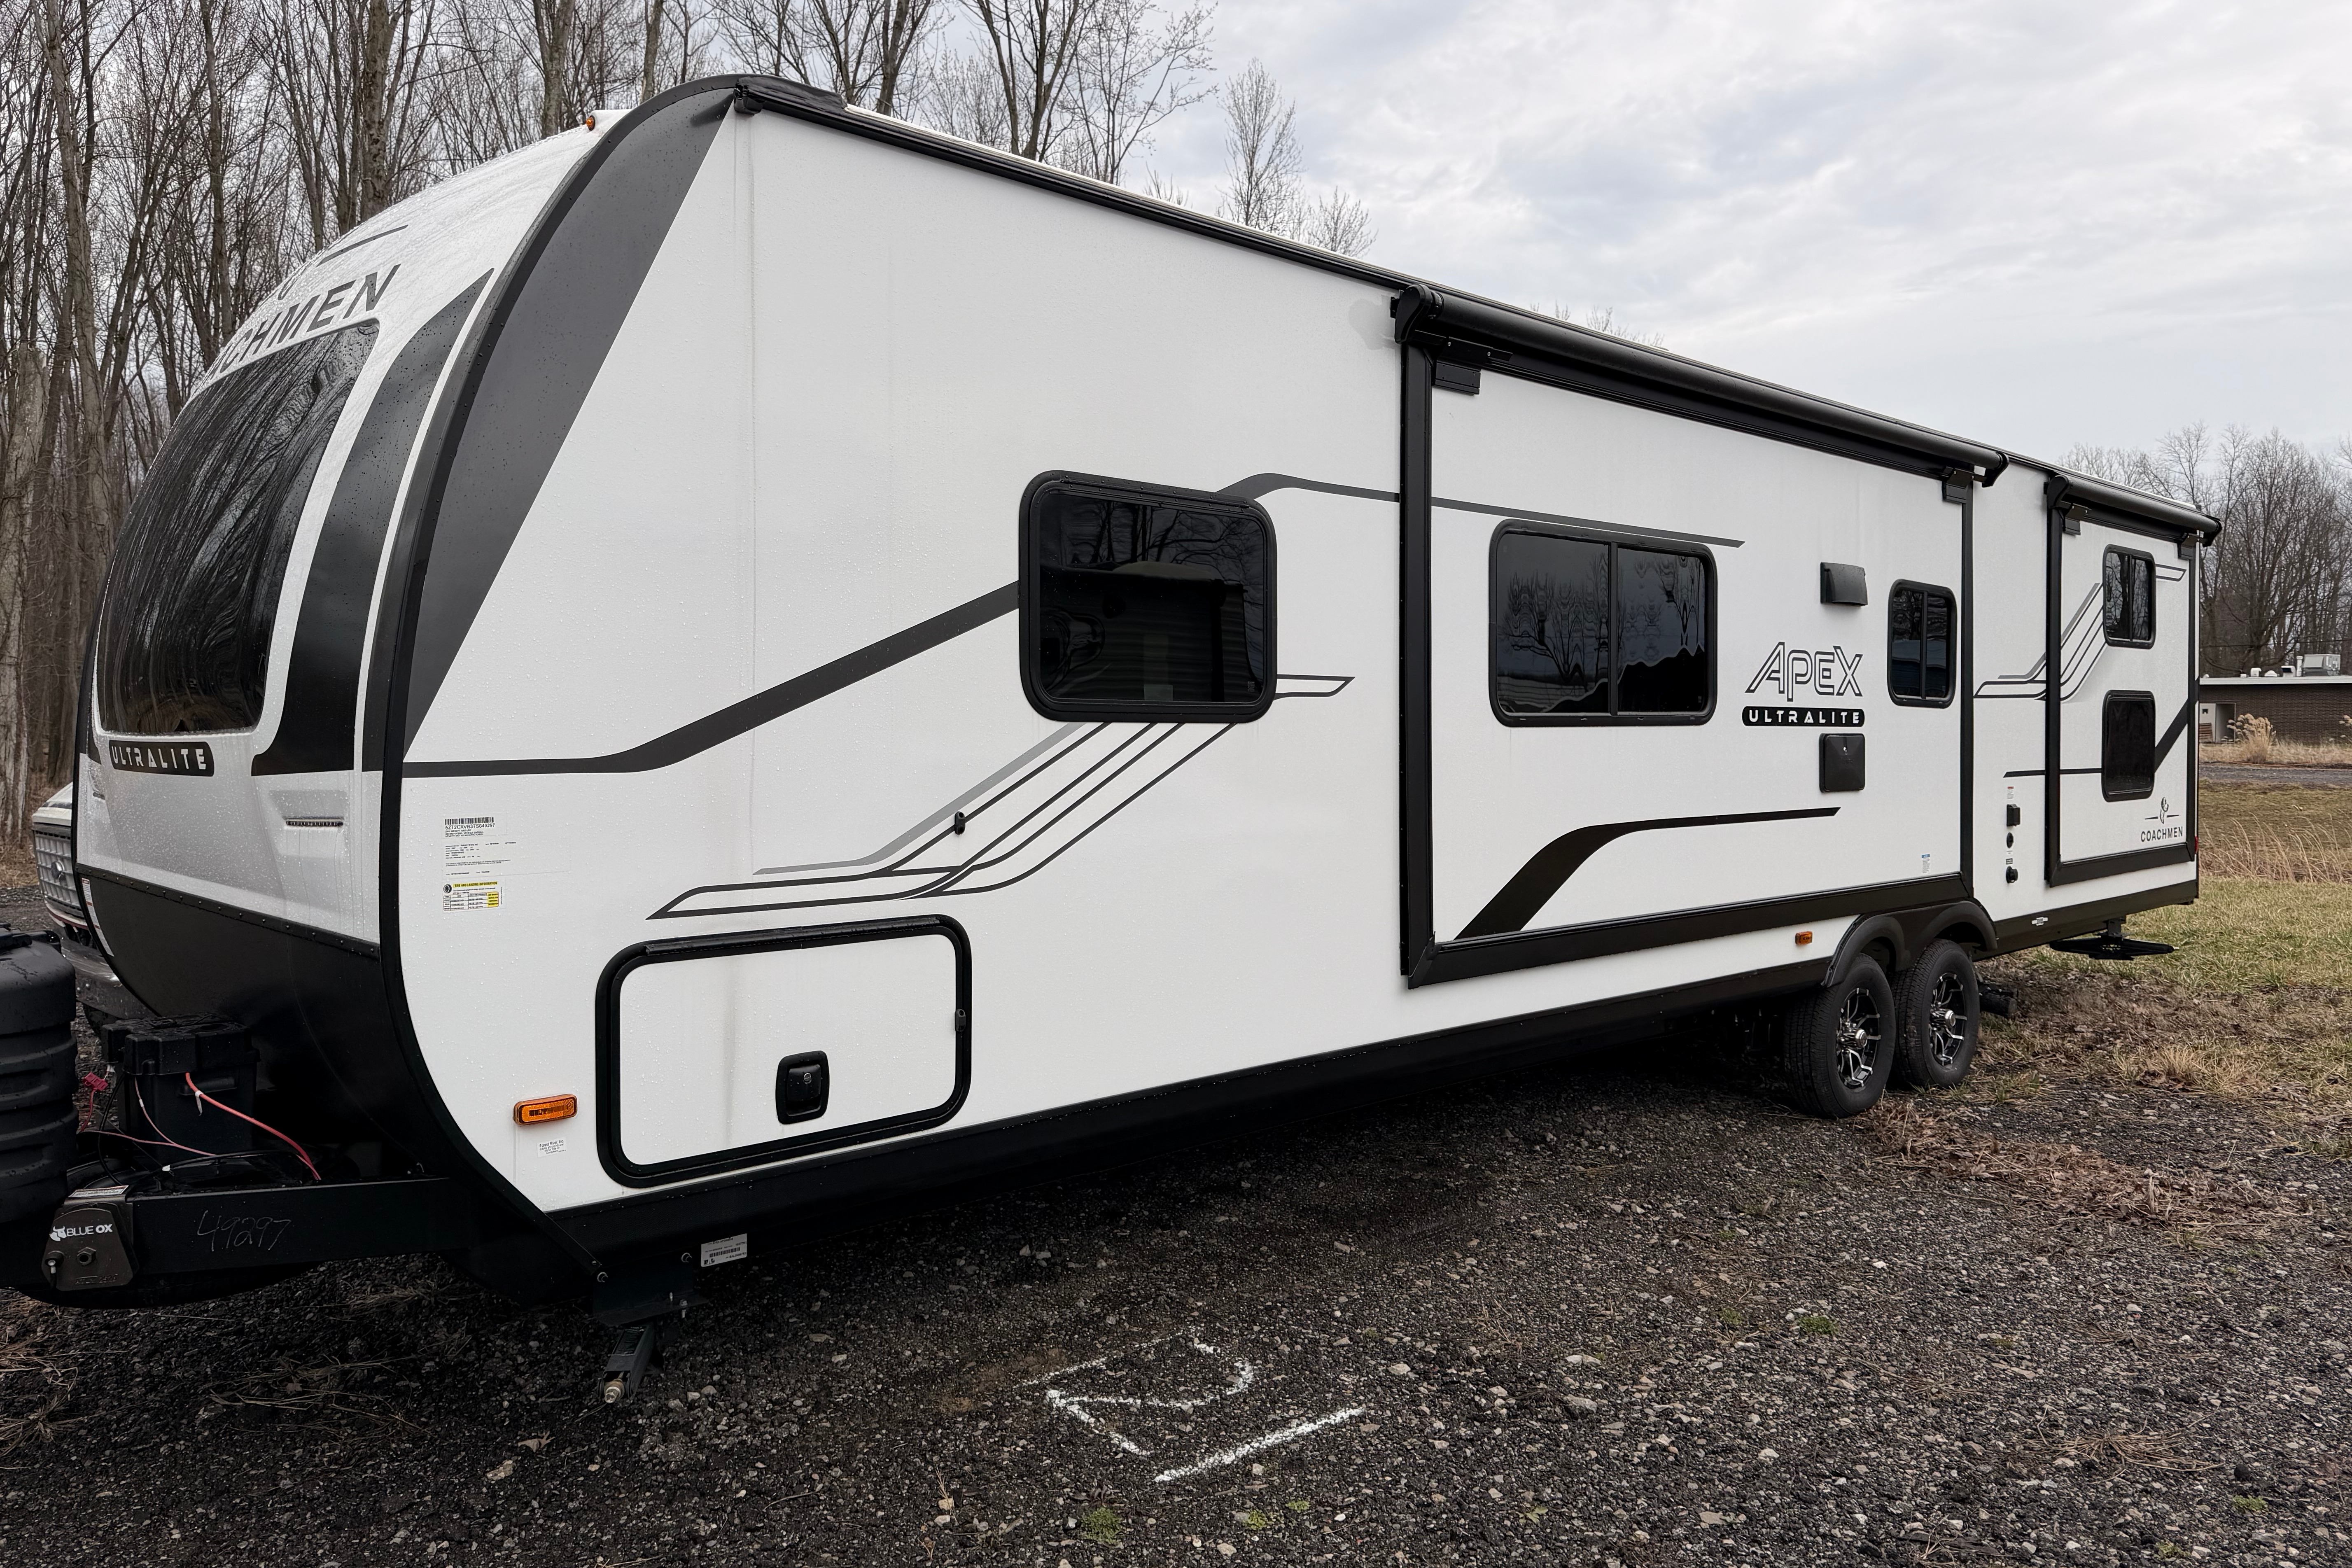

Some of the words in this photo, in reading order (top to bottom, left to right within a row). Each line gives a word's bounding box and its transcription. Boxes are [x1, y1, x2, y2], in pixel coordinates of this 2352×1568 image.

[1744, 642, 1864, 702] APEX
[1749, 709, 1860, 723] ULTRALITE
[111, 746, 206, 770] ULTRALITE
[2141, 826, 2183, 842] COACHMEN
[66, 1225, 94, 1237] BLUE
[95, 1224, 113, 1234] OX
[197, 1210, 292, 1252] 49297
